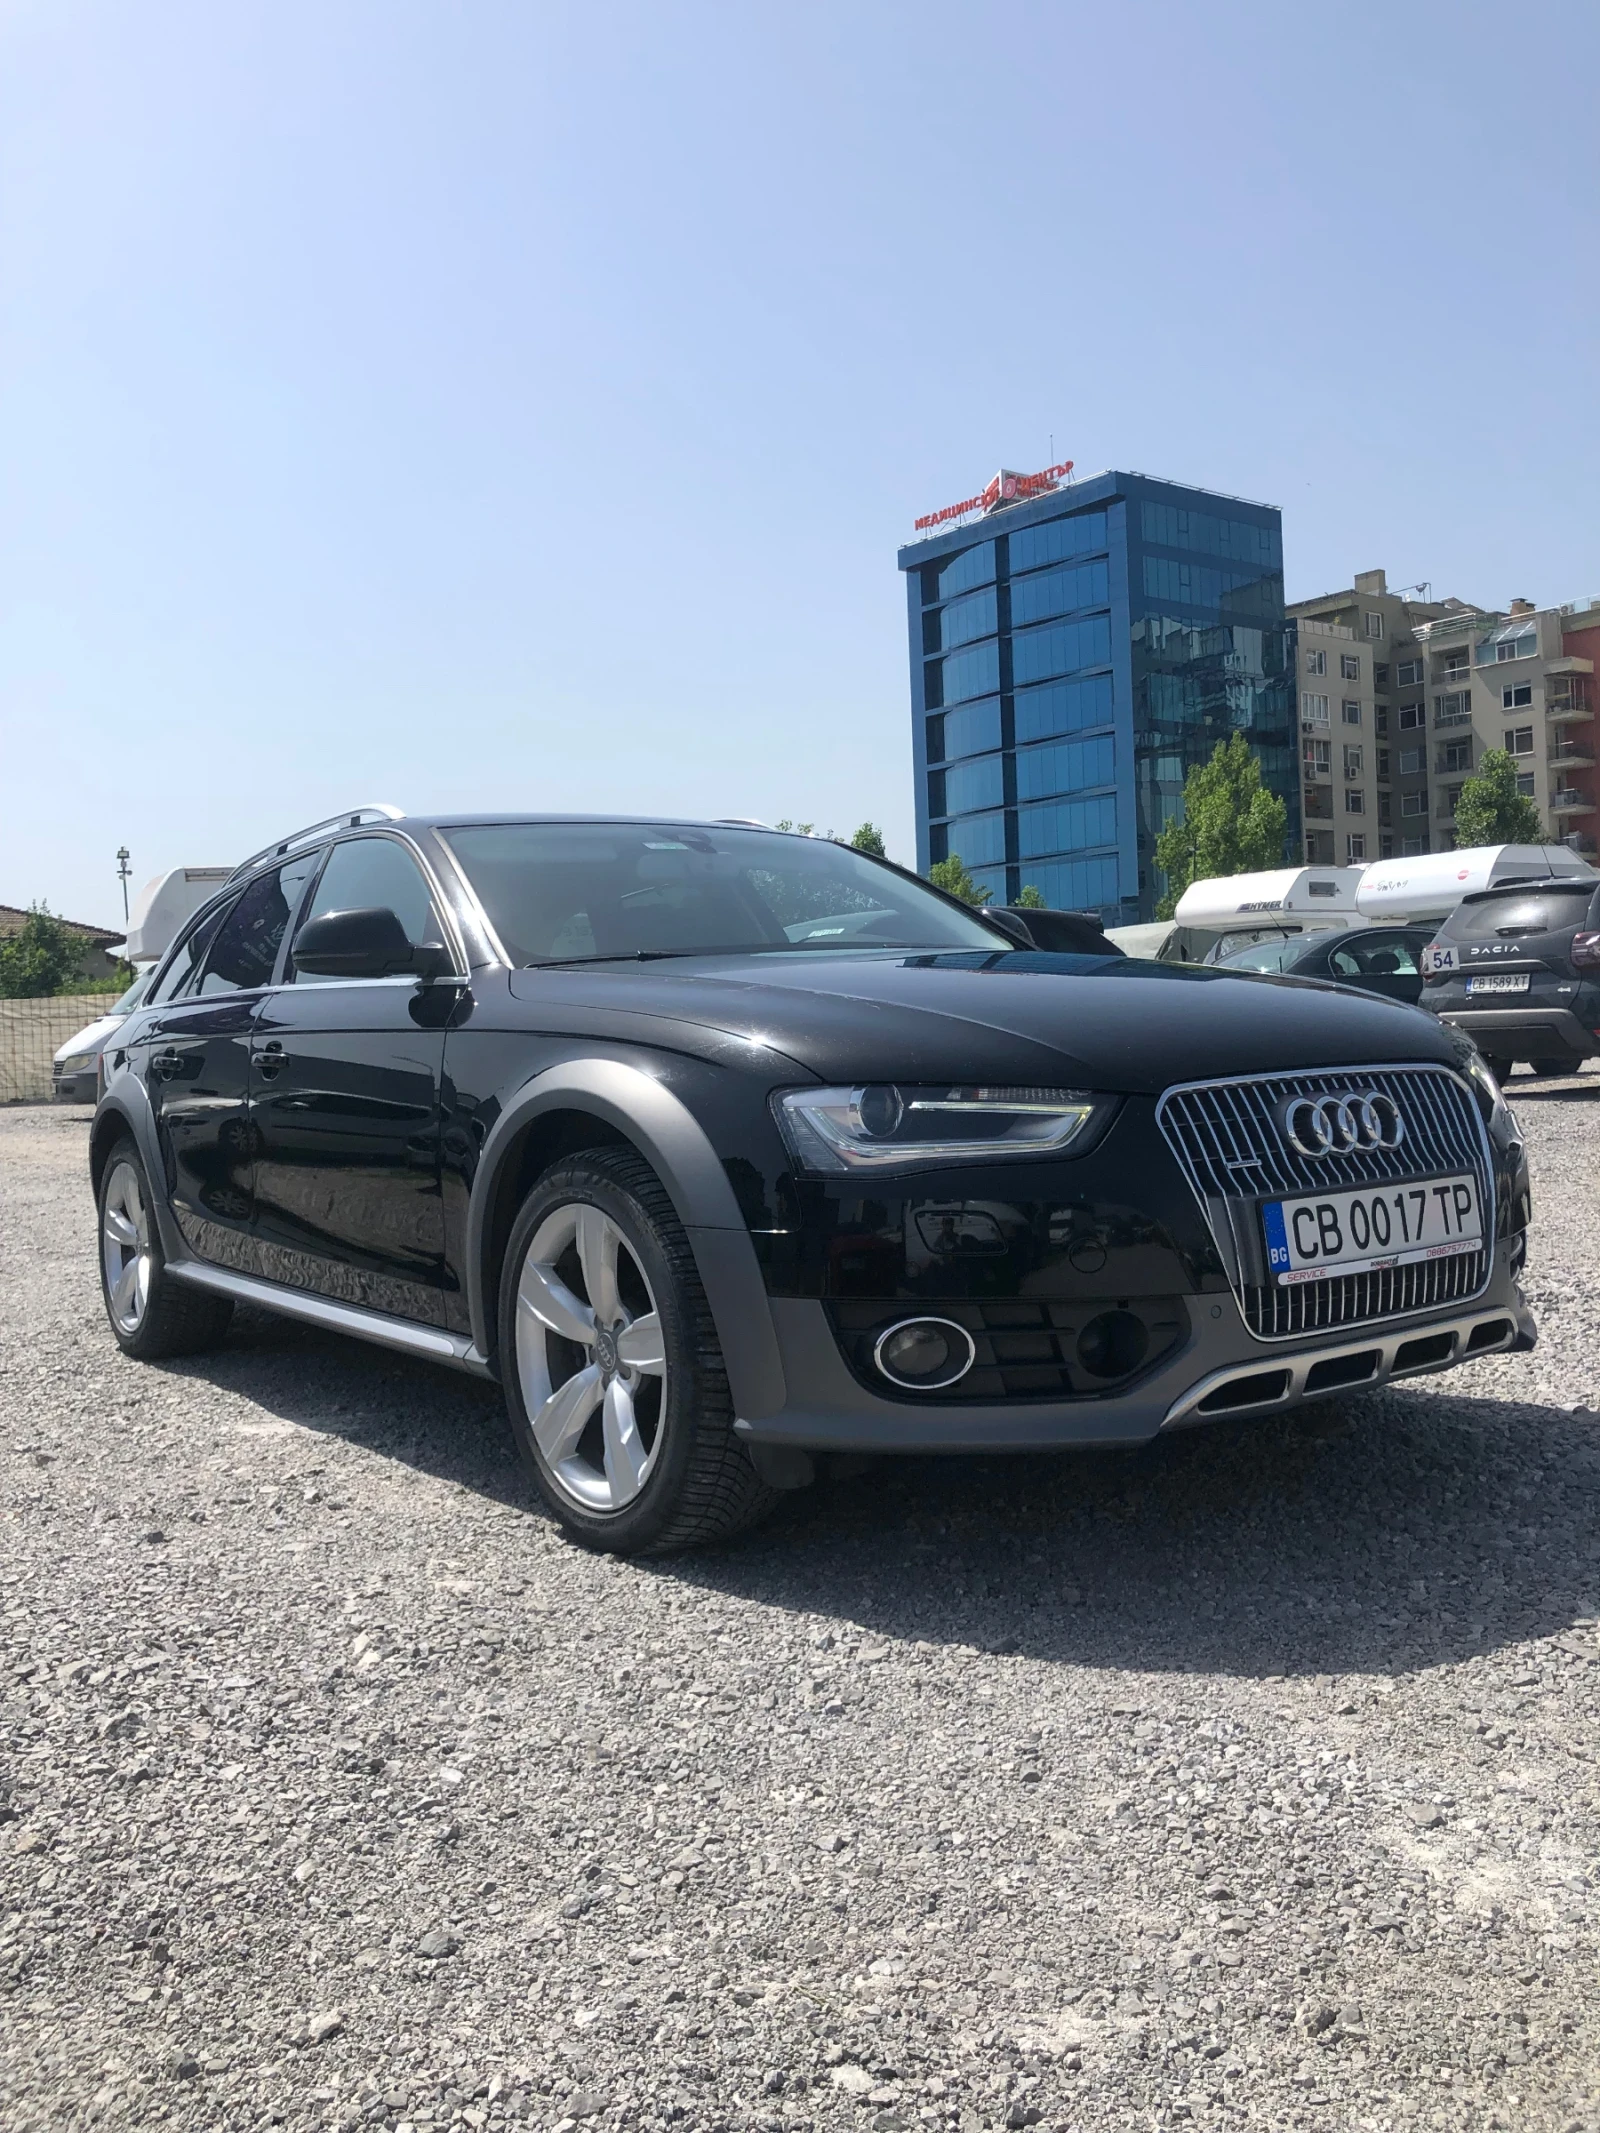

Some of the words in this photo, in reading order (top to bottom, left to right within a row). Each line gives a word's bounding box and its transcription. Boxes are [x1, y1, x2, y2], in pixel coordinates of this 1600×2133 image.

[1249, 900, 1282, 910] HYMER
[1470, 945, 1520, 955] DACIA
[1433, 951, 1453, 969] 54
[1472, 978, 1485, 989] CB
[1488, 976, 1510, 988] 1589
[1514, 975, 1527, 987] XT
[1292, 1203, 1343, 1260] CB
[1350, 1190, 1426, 1250] 0017
[1432, 1183, 1472, 1236] TP
[1270, 1247, 1288, 1265] BG
[1286, 1268, 1327, 1283] SERVICE
